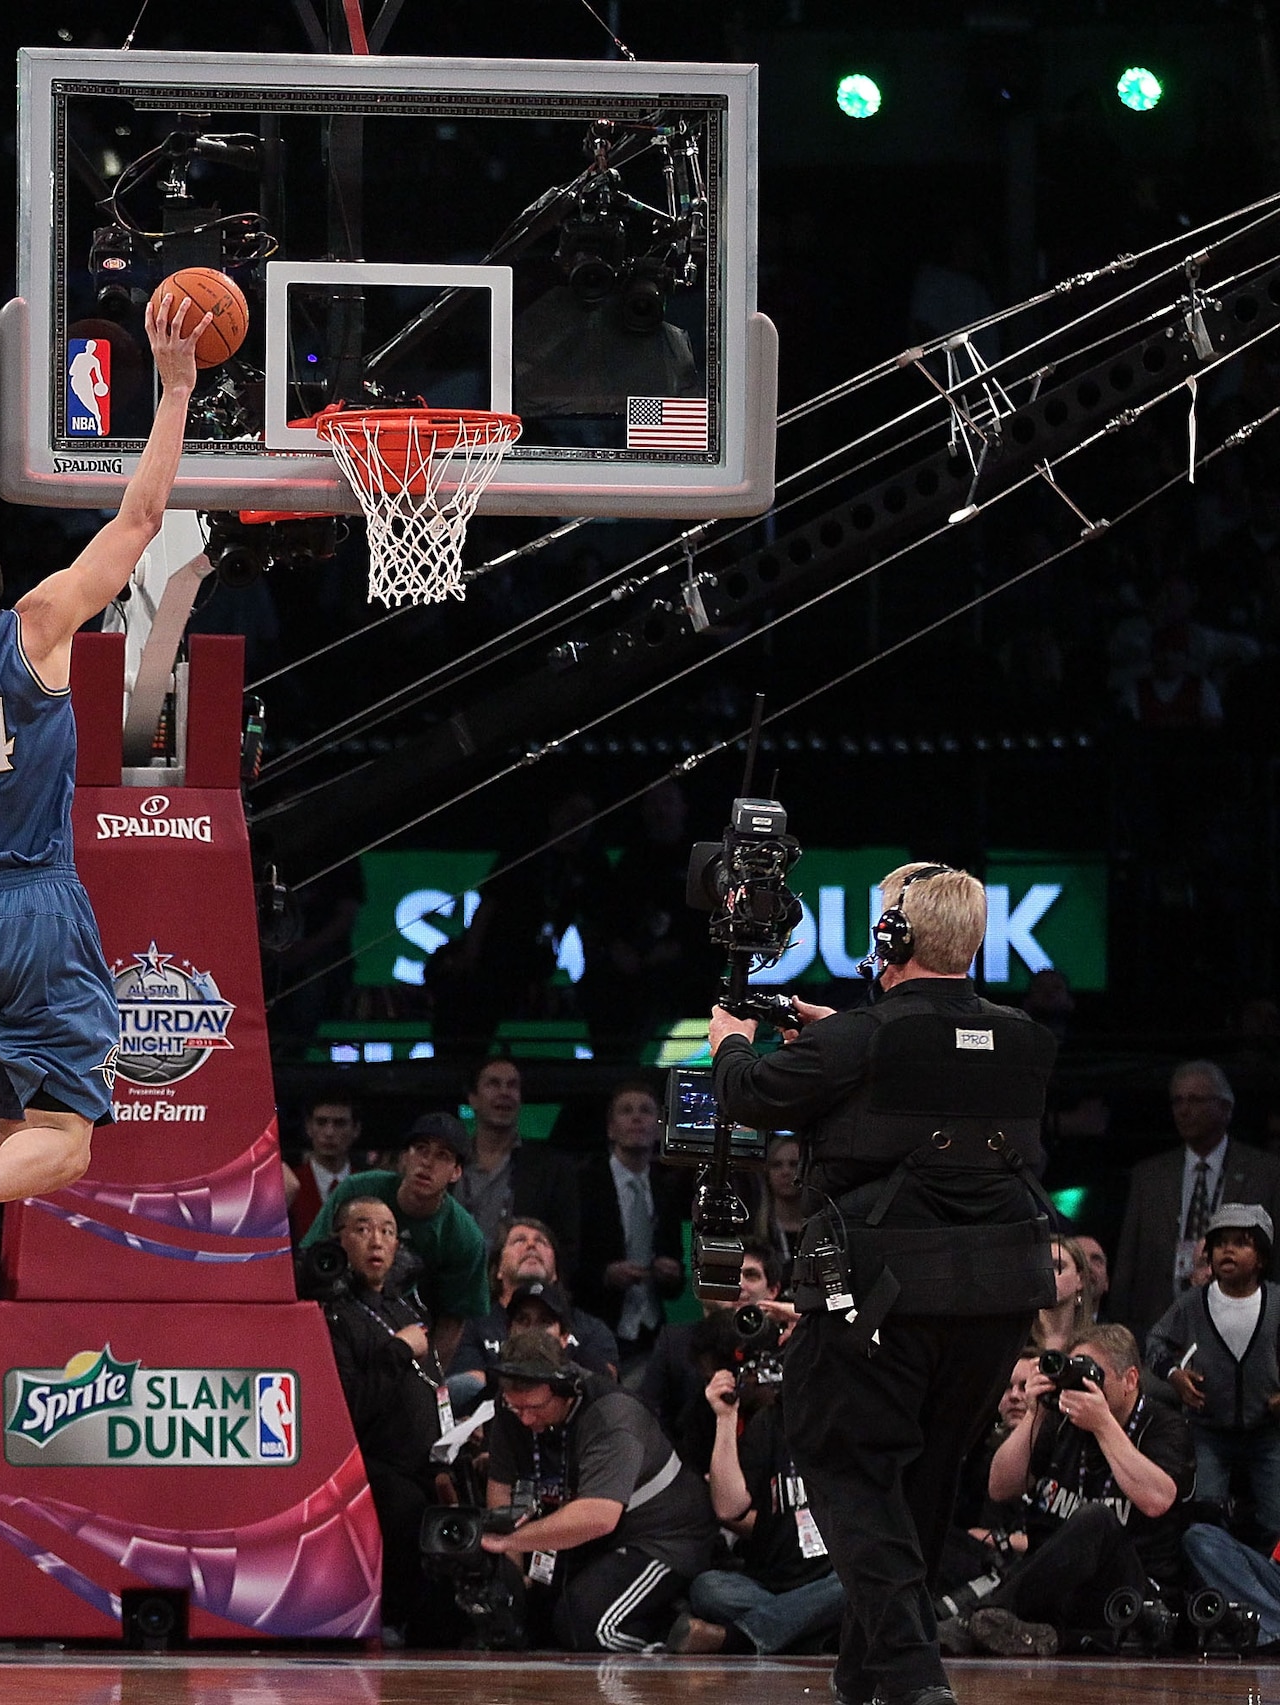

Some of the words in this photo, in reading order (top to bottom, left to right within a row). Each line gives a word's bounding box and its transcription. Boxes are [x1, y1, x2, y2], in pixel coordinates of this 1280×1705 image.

[71, 416, 97, 431] NBA
[53, 458, 123, 474] SPALDING
[96, 813, 213, 843] SPALDING
[119, 1009, 230, 1033] TURDAY
[122, 1036, 186, 1053] NIGHT
[961, 1033, 990, 1046] PRO
[128, 1088, 163, 1096] Presented
[166, 1088, 176, 1097] by
[112, 1101, 151, 1122] tate
[153, 1101, 206, 1122] Farm
[22, 1363, 127, 1434] Sprite
[146, 1376, 251, 1410] SLAM
[108, 1415, 251, 1459] DUNK
[261, 1442, 285, 1456] NBA
